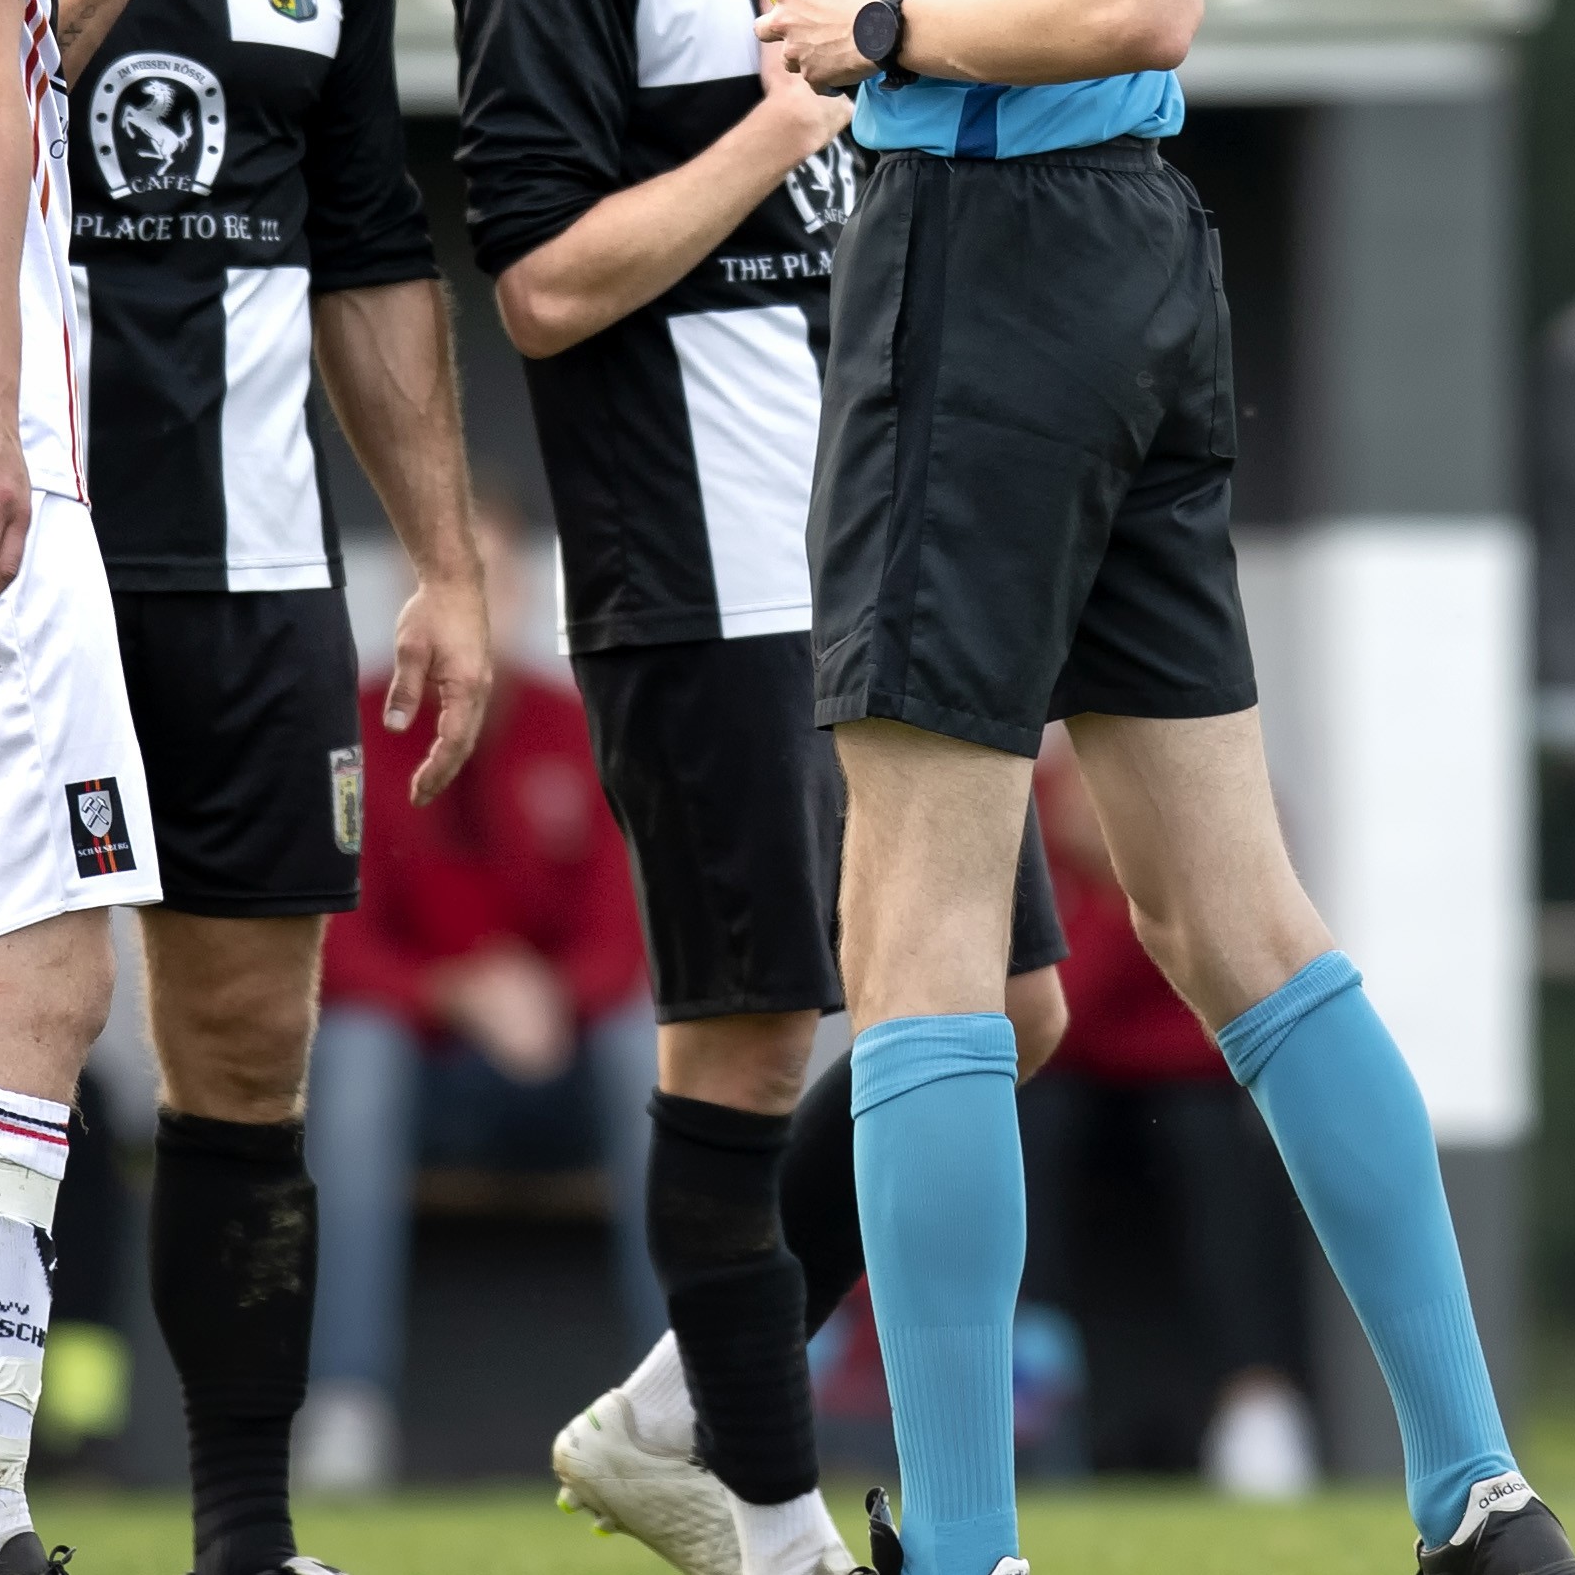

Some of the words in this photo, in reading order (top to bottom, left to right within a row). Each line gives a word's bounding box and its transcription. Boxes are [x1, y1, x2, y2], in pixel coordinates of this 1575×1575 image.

[75, 212, 175, 242] PLACE
[179, 212, 217, 239] TO
[223, 213, 252, 240] BE
[719, 256, 777, 283] THE
[781, 249, 832, 279] PLA
[1478, 1481, 1529, 1509] adida
